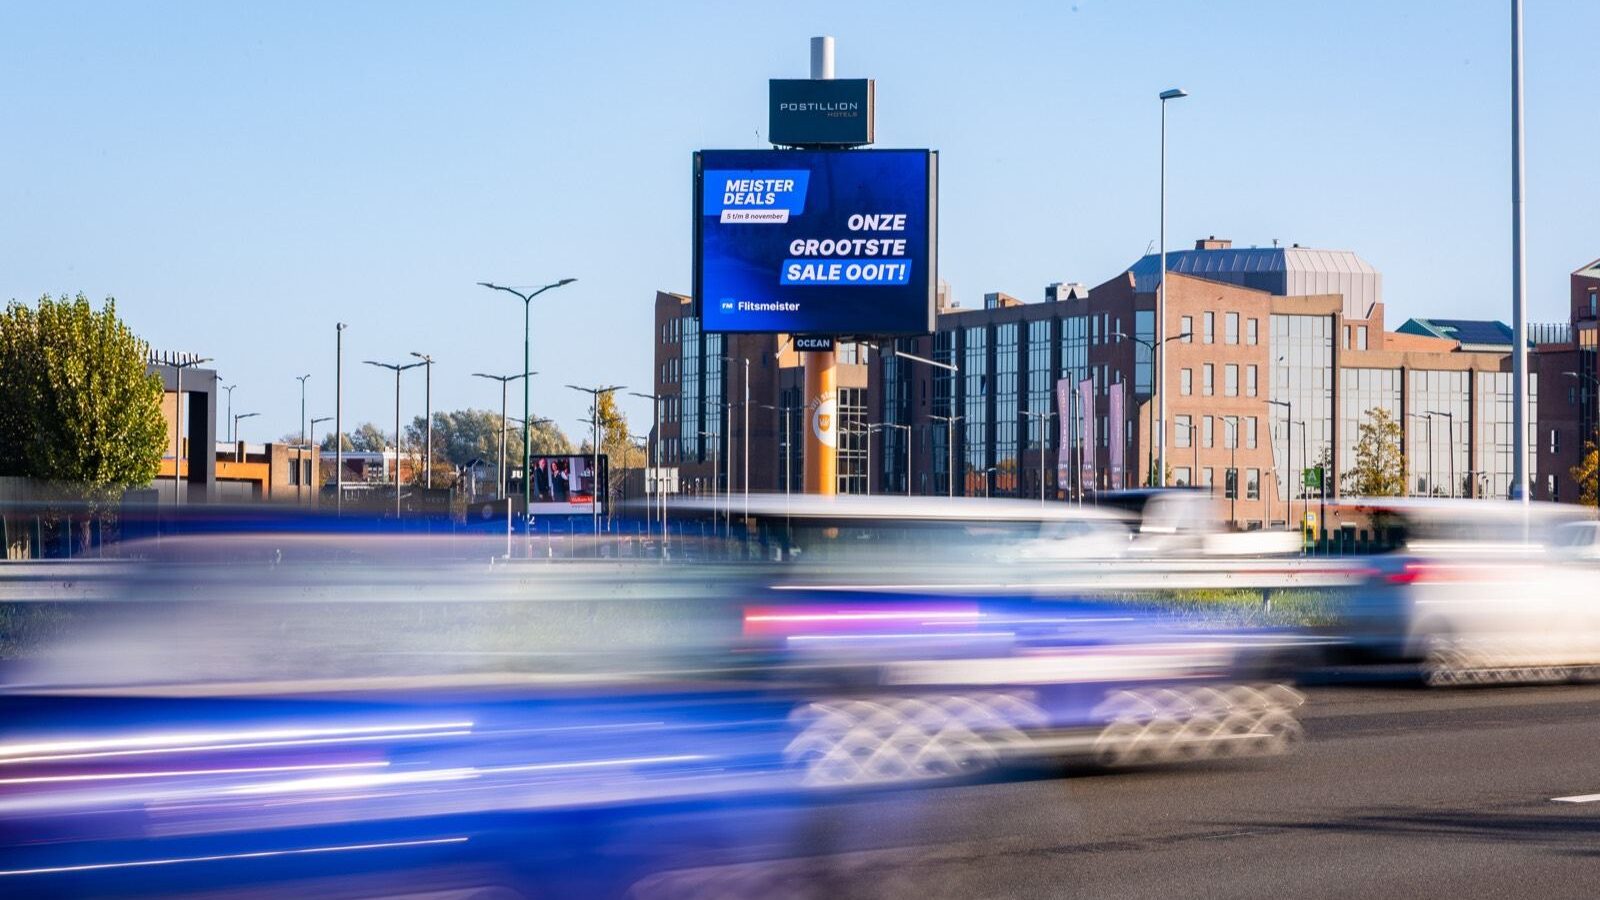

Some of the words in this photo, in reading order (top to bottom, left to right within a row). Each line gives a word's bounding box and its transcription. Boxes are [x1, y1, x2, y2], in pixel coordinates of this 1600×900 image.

[780, 102, 858, 111] POSTILLION
[725, 179, 794, 192] MEISTER
[723, 192, 776, 205] DEALS
[847, 214, 907, 231] ONZE
[789, 239, 907, 256] GROOTSTE
[787, 264, 842, 281] SALE
[845, 264, 905, 281] OOIT!
[738, 301, 801, 311] Flitsmeister
[797, 339, 830, 347] OCEAN
